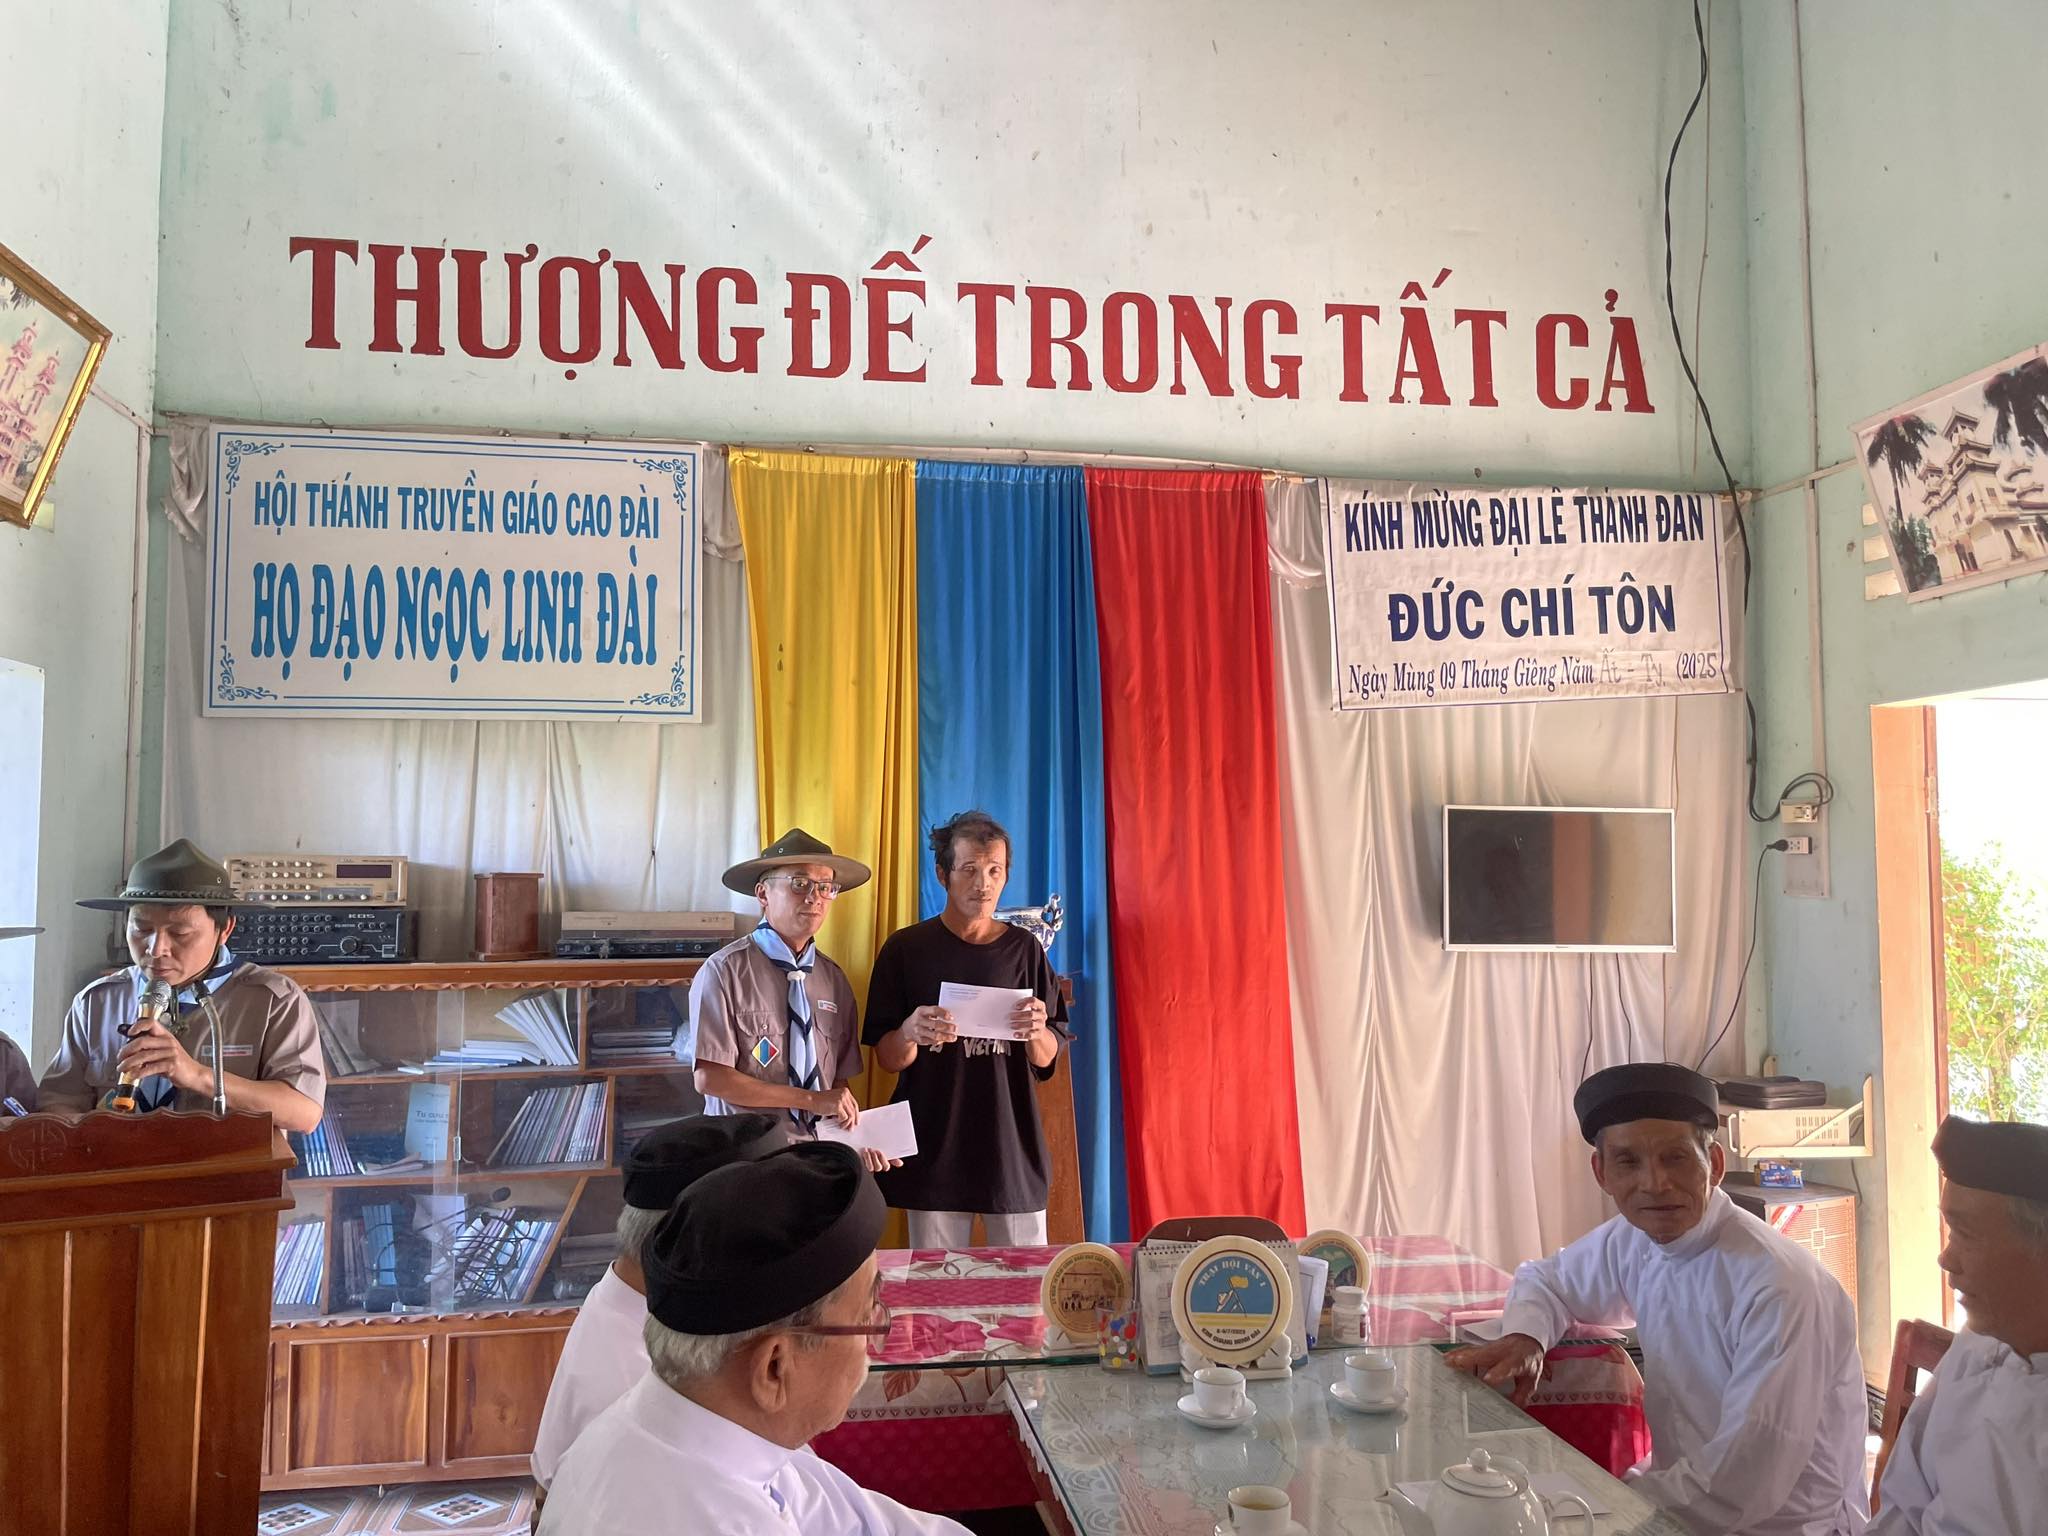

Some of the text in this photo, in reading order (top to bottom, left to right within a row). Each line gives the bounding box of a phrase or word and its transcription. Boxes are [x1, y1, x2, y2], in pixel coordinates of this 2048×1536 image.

[290, 234, 1656, 414] THƯỢNG ĐẾ TRONG TẤT CẢ
[254, 470, 660, 539] HỘI THÁNH TRUYỀN GIÁO CAO ĐÀI
[1344, 490, 1404, 553] KÍNH
[1411, 488, 1484, 549] MỪNG
[1489, 497, 1531, 557] ĐẠI
[250, 545, 659, 684] HỌ ĐẠO NGỌC LINH ĐÀI
[1387, 571, 1676, 642] ĐỨC CHÍ TÔN
[1348, 664, 1388, 701] Ngày
[1392, 661, 1435, 698] Mùng
[1440, 661, 1457, 690] 09
[1461, 659, 1509, 695] Tháng
[1514, 656, 1557, 693] Giêng
[1560, 655, 1595, 685] Năm
